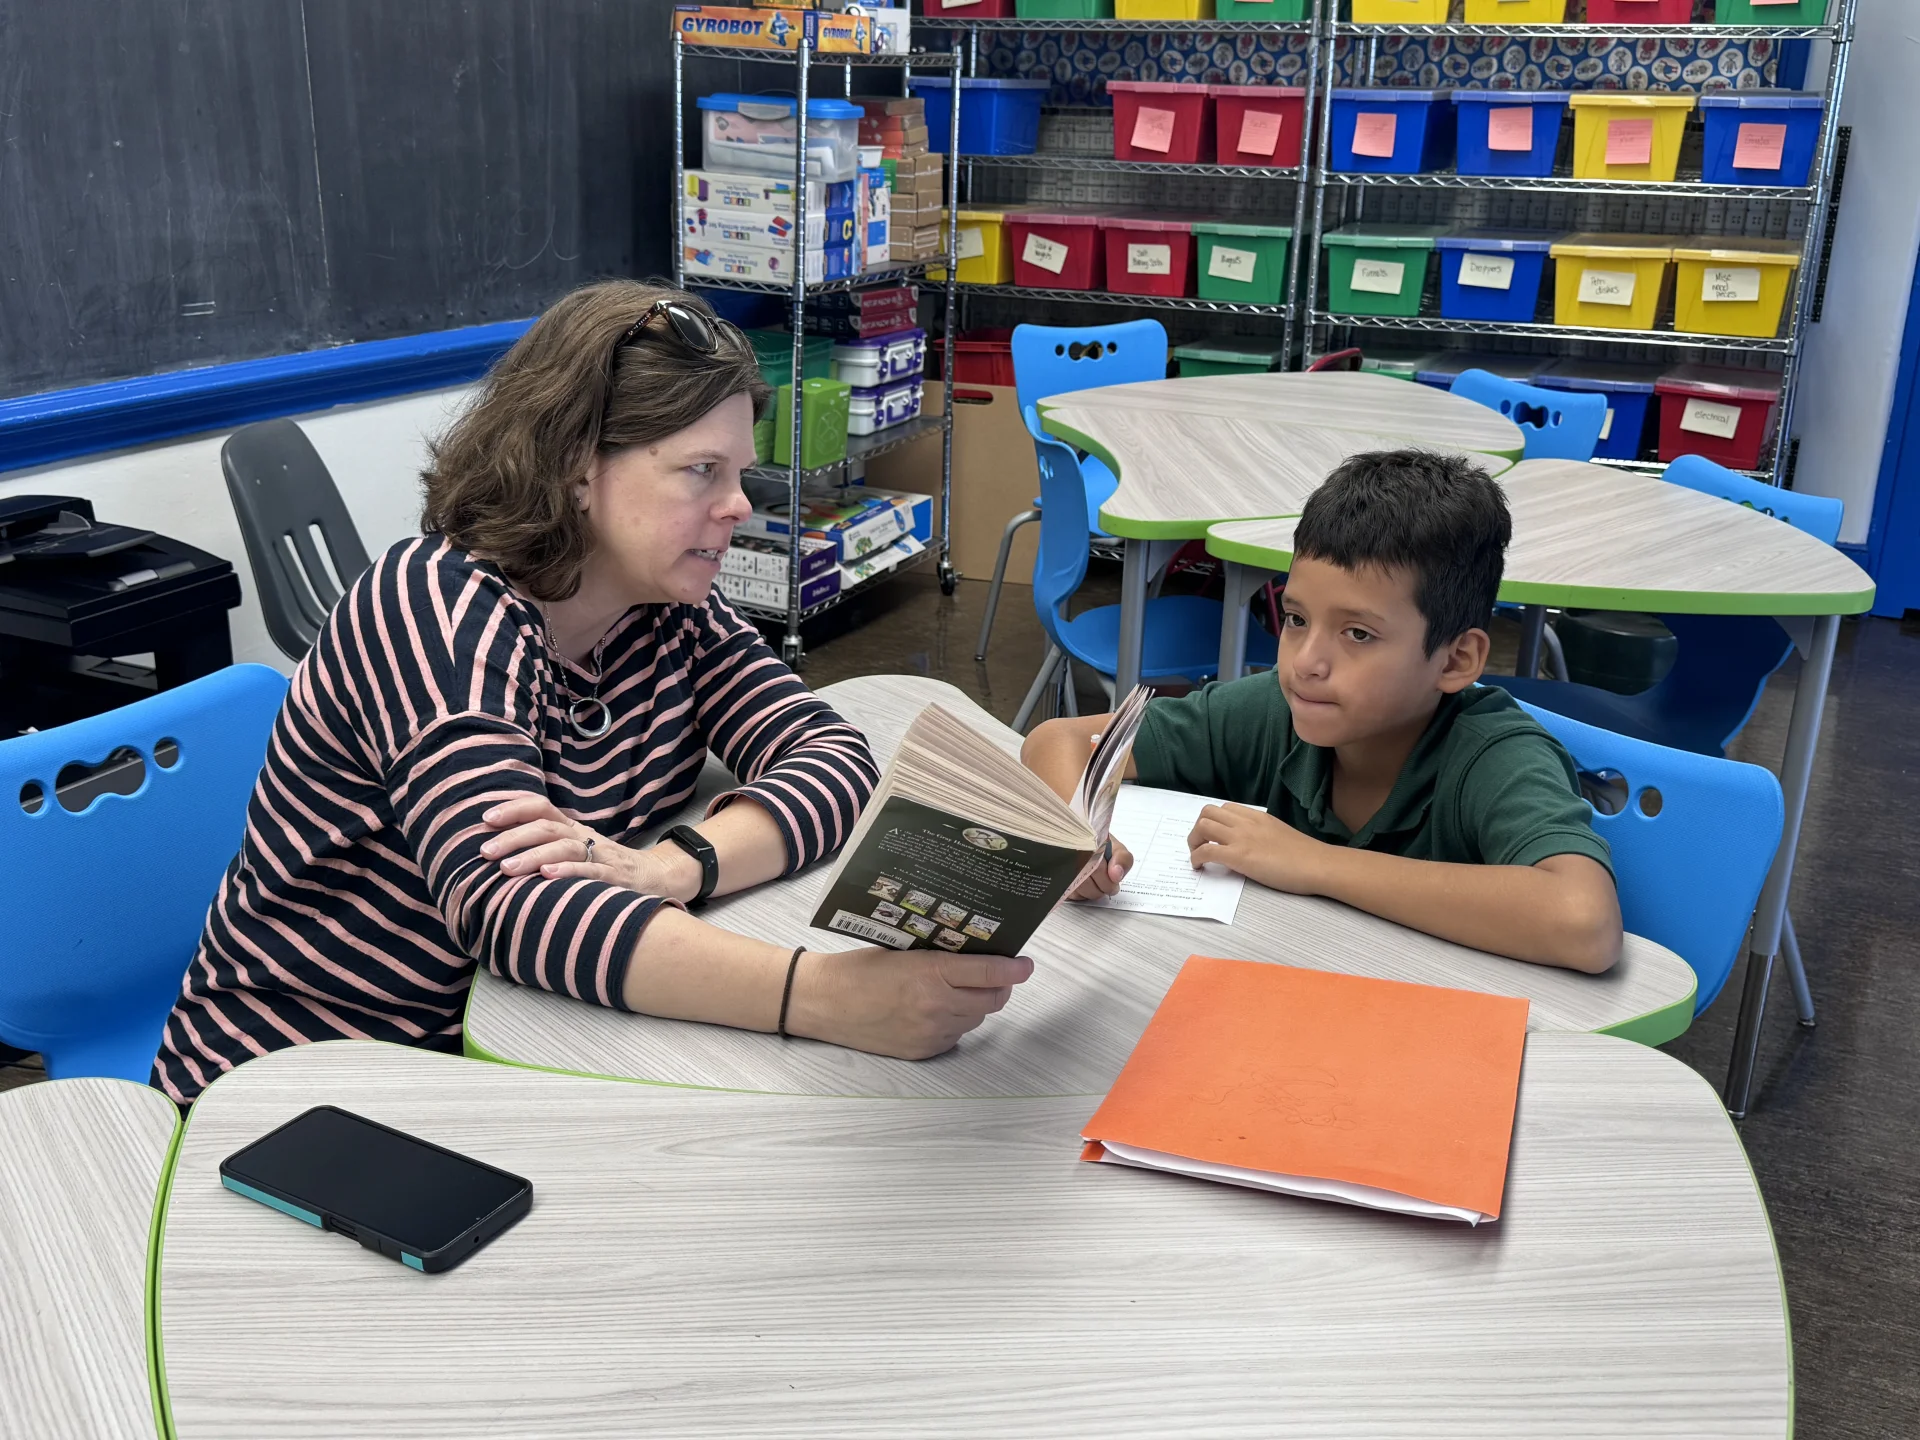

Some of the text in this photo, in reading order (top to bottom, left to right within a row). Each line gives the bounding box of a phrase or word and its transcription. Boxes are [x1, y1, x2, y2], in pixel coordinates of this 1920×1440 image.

[682, 17, 764, 35] GYROBOT
[823, 27, 852, 40] GYROBOT
[1470, 262, 1502, 275] Droppers
[1694, 410, 1729, 424] electrical
